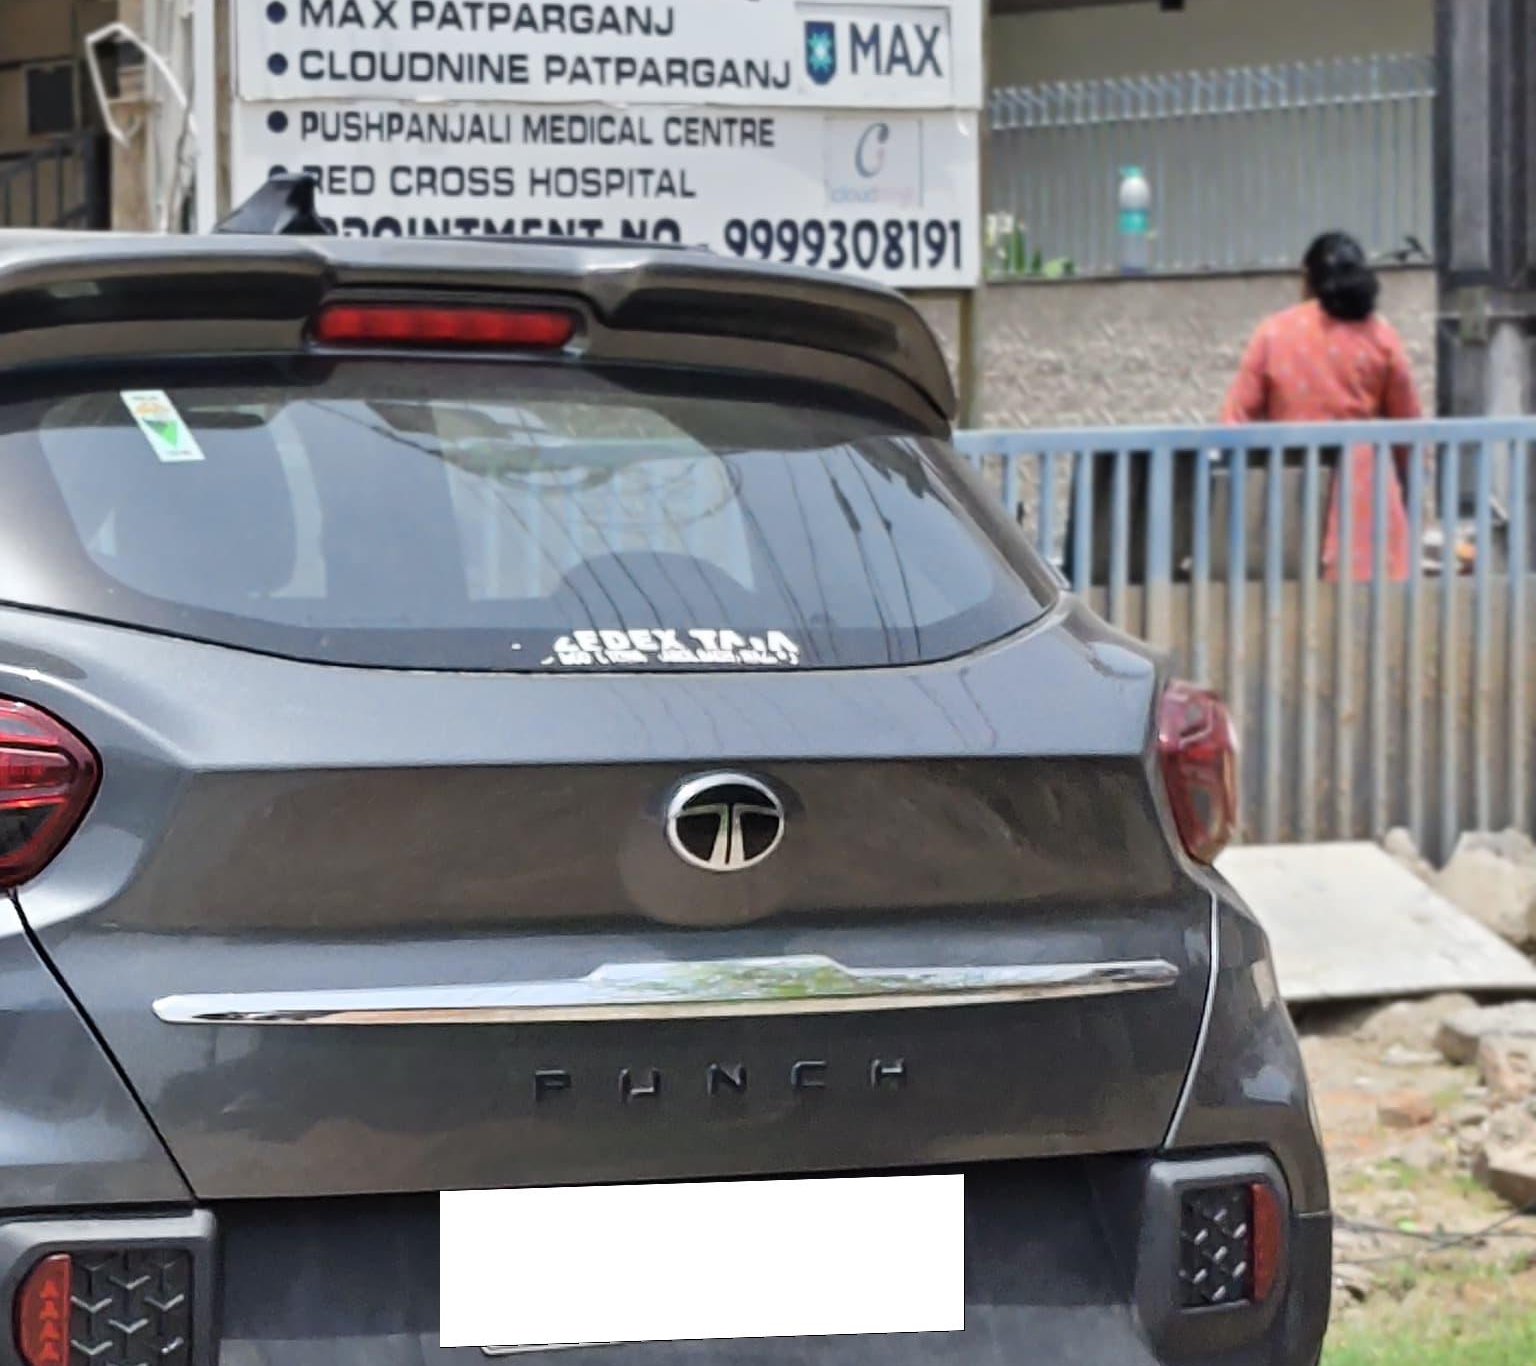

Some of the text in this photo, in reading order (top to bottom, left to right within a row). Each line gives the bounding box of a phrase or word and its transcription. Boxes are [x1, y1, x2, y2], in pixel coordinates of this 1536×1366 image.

[410, 0, 675, 37] PATPARGANJ
[299, 49, 792, 91] CLOUDNINE PATPARGANJ
[849, 21, 944, 79] MAX
[300, 110, 776, 148] PUSHPANJALI MEDICAL CENTRE
[302, 164, 697, 199] RED CROSS HOSPITAL
[723, 218, 962, 271] 9999308191
[534, 1057, 905, 1103] PUNCH
